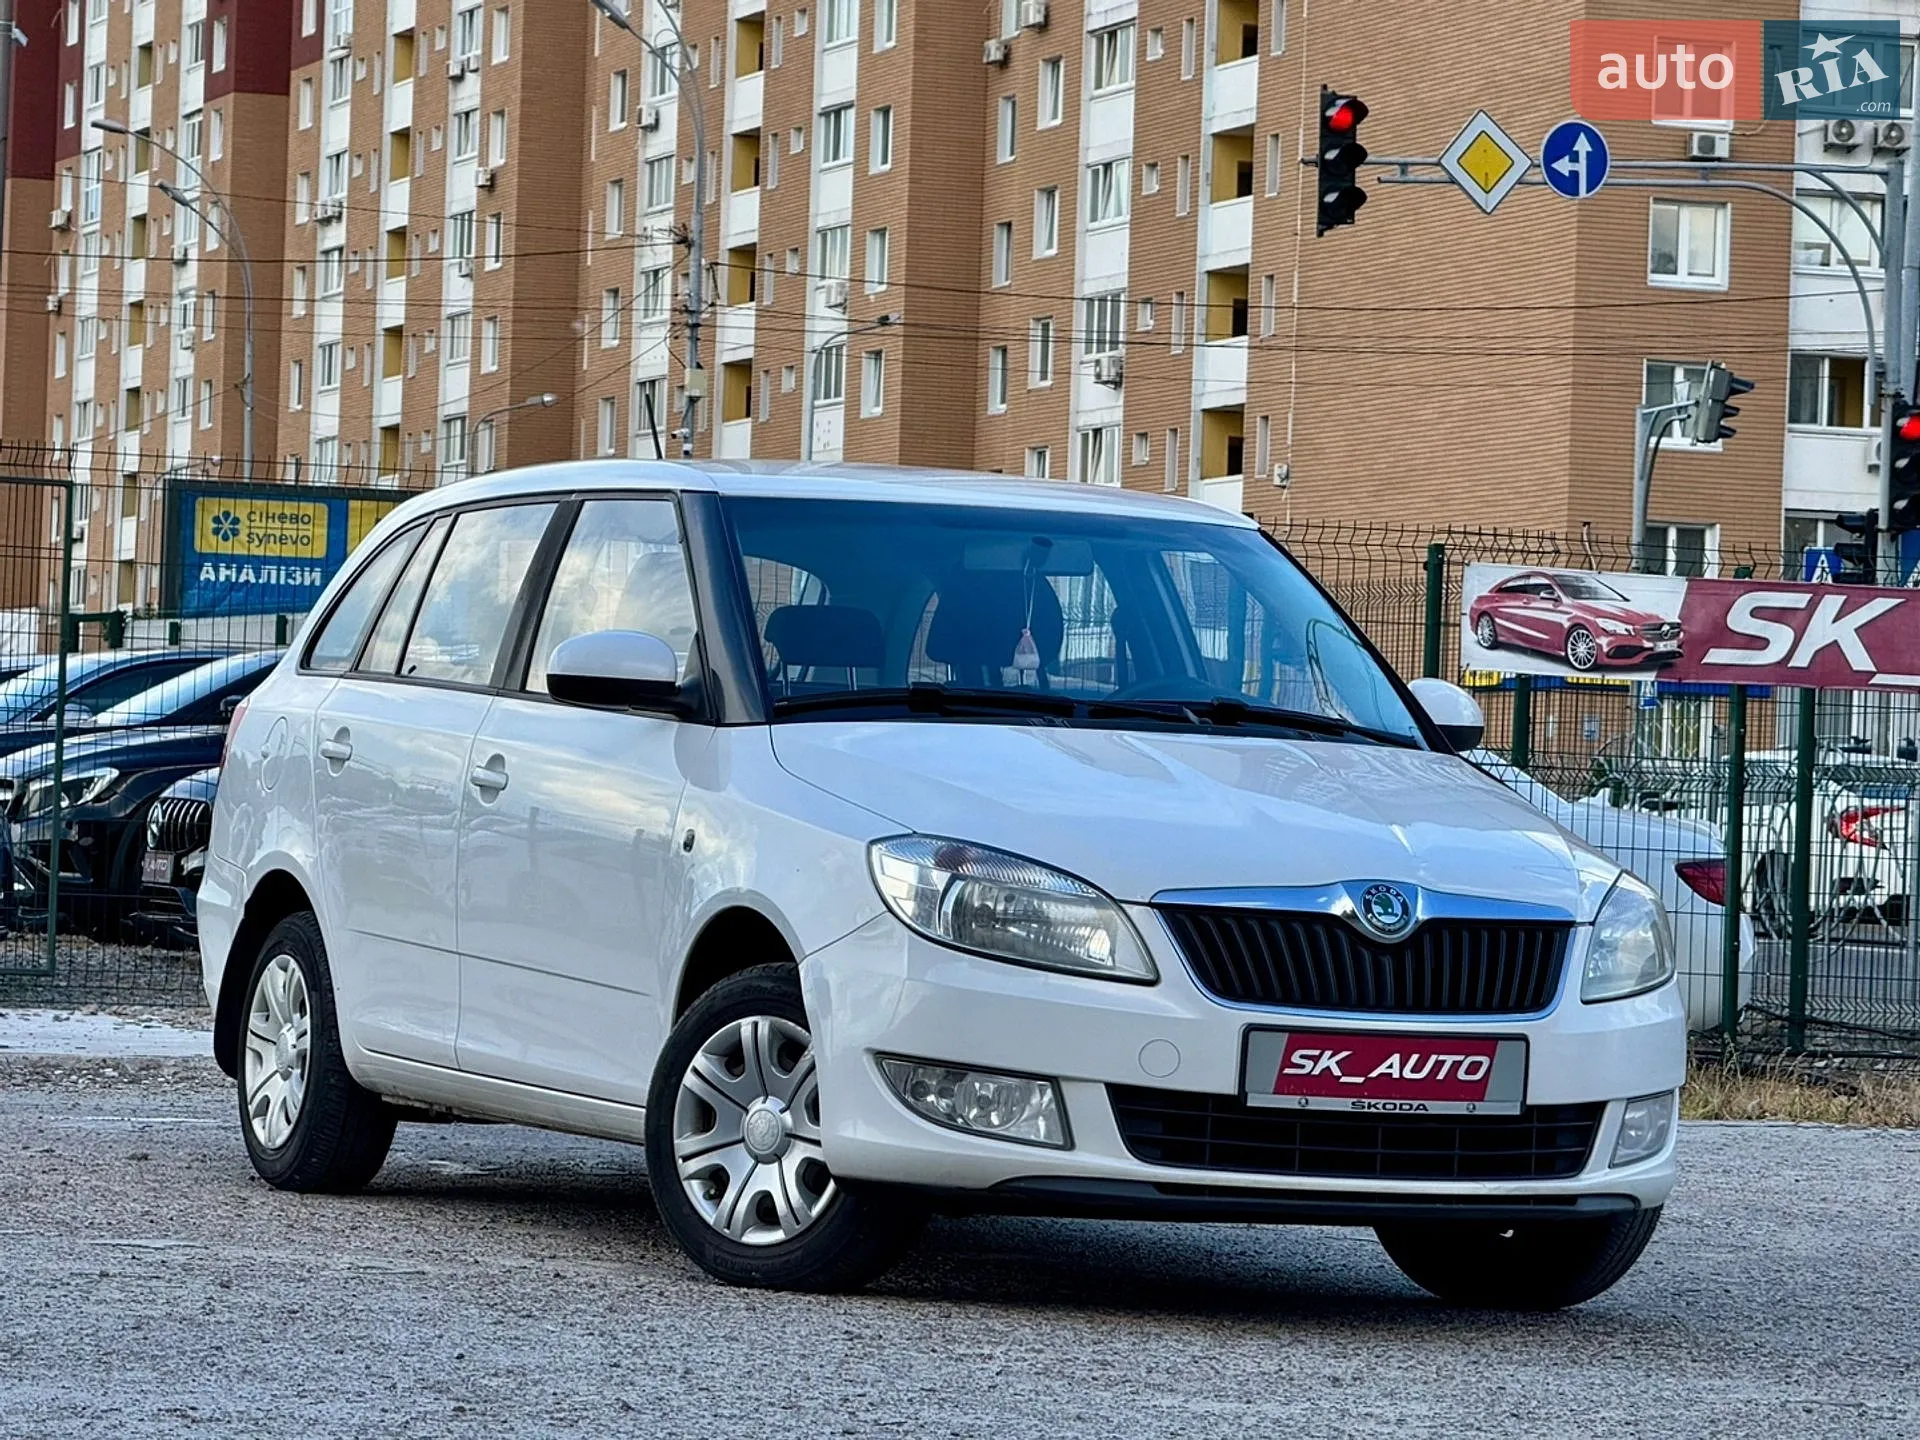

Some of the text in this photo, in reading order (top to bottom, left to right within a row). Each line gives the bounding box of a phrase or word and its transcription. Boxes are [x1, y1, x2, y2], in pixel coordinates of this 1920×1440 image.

[247, 532, 311, 548] synevo
[200, 562, 322, 586] АНАЛІЗИ
[1282, 1049, 1491, 1083] SK_AUTO
